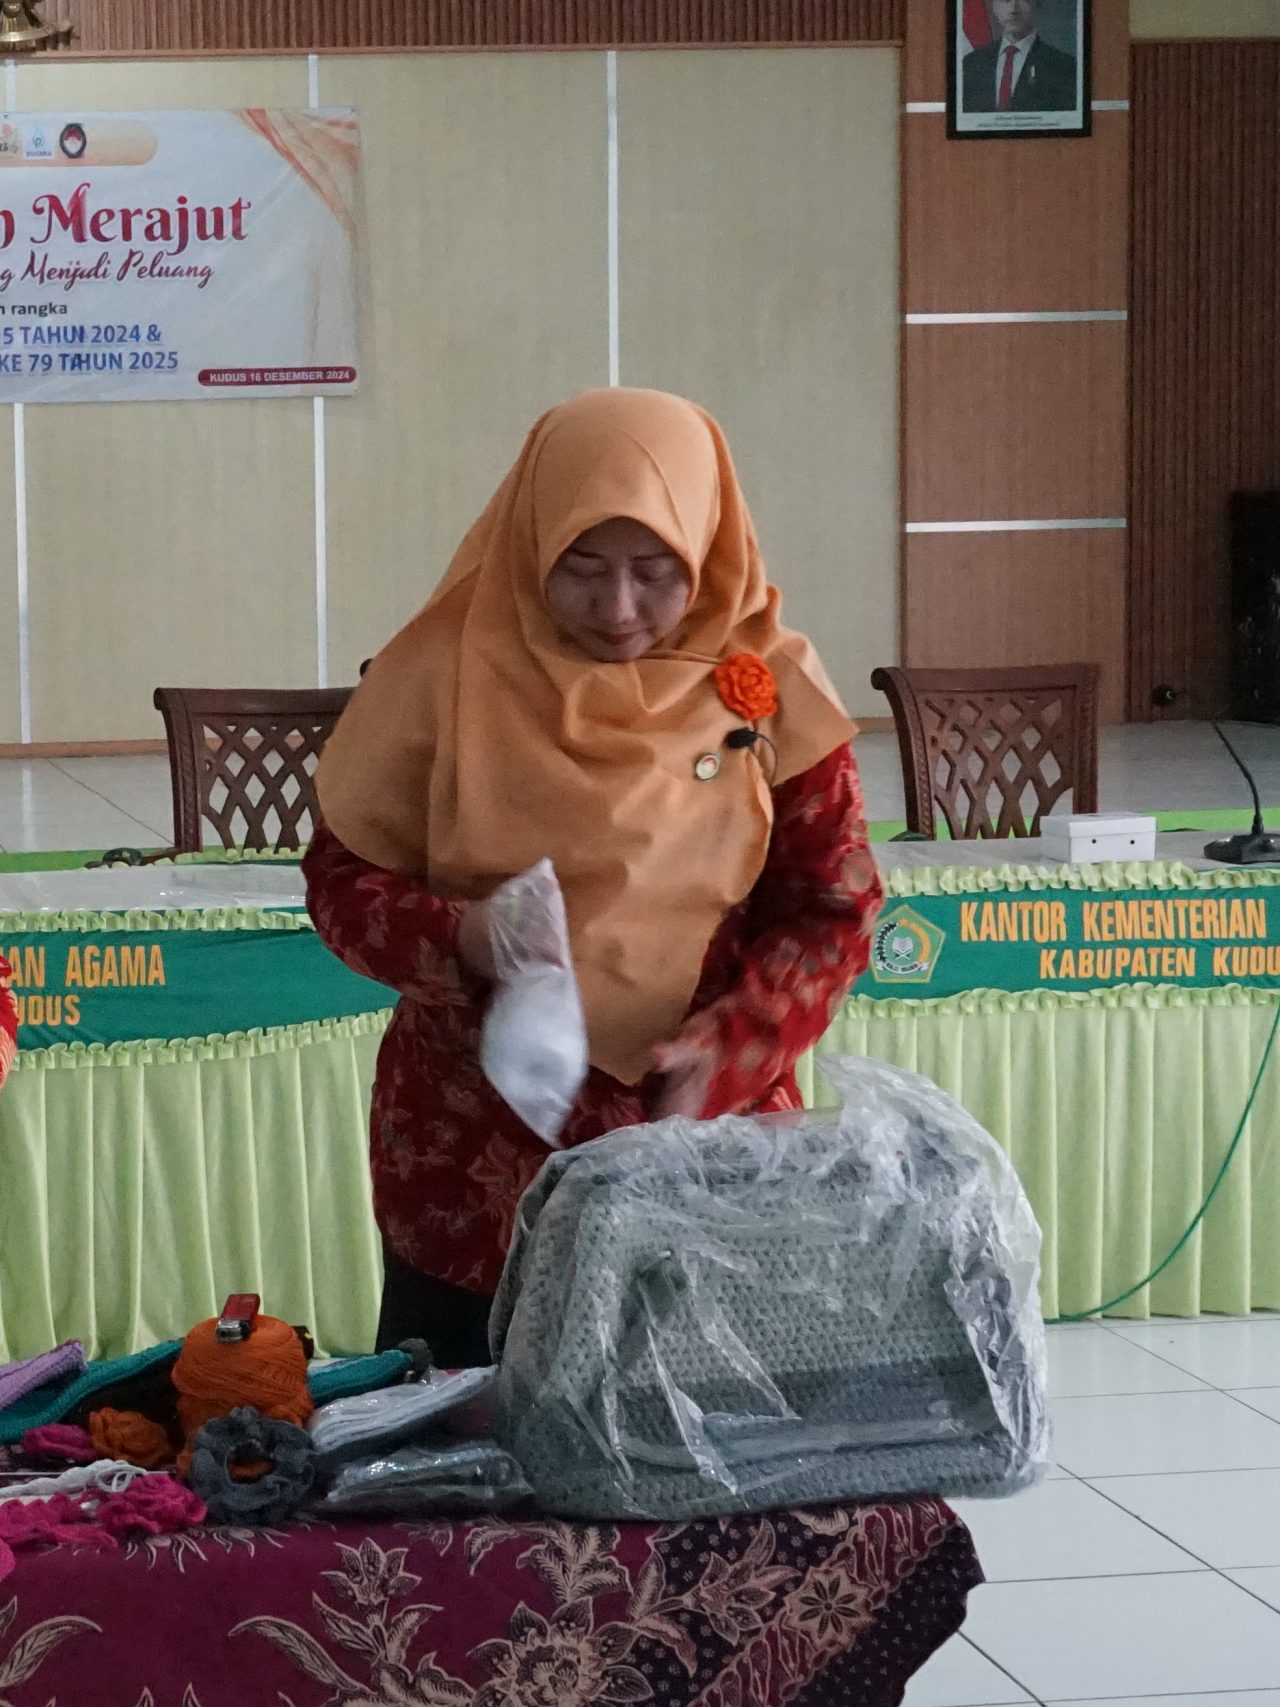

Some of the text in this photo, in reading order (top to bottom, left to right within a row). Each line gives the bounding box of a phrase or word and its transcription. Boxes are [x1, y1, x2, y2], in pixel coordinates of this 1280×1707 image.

[29, 182, 252, 256] Merajut
[20, 249, 112, 291] Menjadi
[116, 248, 215, 289] Peluang
[11, 302, 68, 317] rangka
[20, 325, 85, 344] TAHUN
[91, 324, 140, 343] 2024
[147, 323, 161, 342] &
[29, 353, 53, 372] 79
[59, 352, 123, 371] TAHUN
[129, 351, 178, 370] 2025
[209, 373, 247, 382] KUDUS
[264, 371, 323, 382] DESEMBER
[326, 371, 350, 380] 2024
[960, 898, 1267, 943] KANTOR KEMENTERIAN
[65, 945, 166, 988] AGAMA
[1039, 947, 1196, 979] KABUPATEN
[18, 994, 81, 1026] DUS
